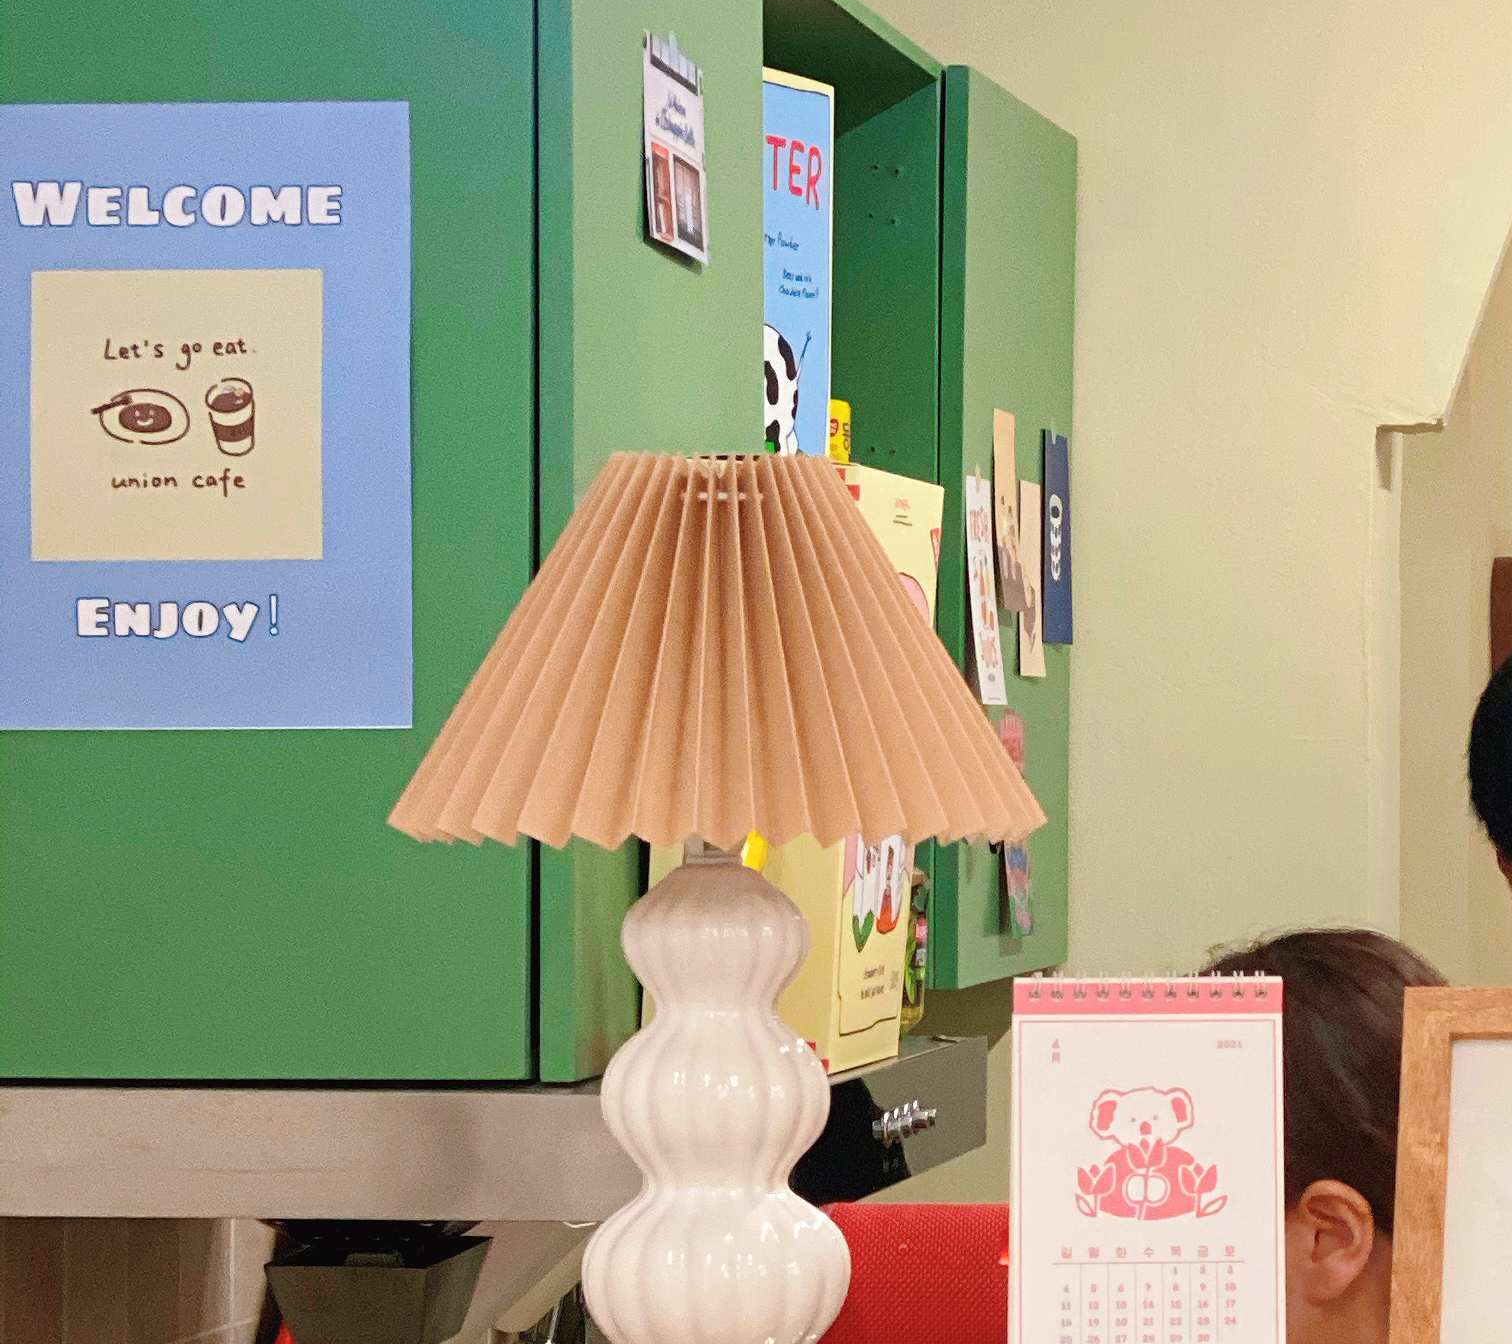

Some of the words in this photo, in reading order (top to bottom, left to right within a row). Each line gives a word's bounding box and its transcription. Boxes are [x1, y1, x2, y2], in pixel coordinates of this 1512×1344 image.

[11, 180, 343, 227] WELCOME
[104, 338, 163, 360] Let's
[176, 342, 202, 370] go
[111, 473, 178, 489] union
[192, 468, 246, 497] cafe
